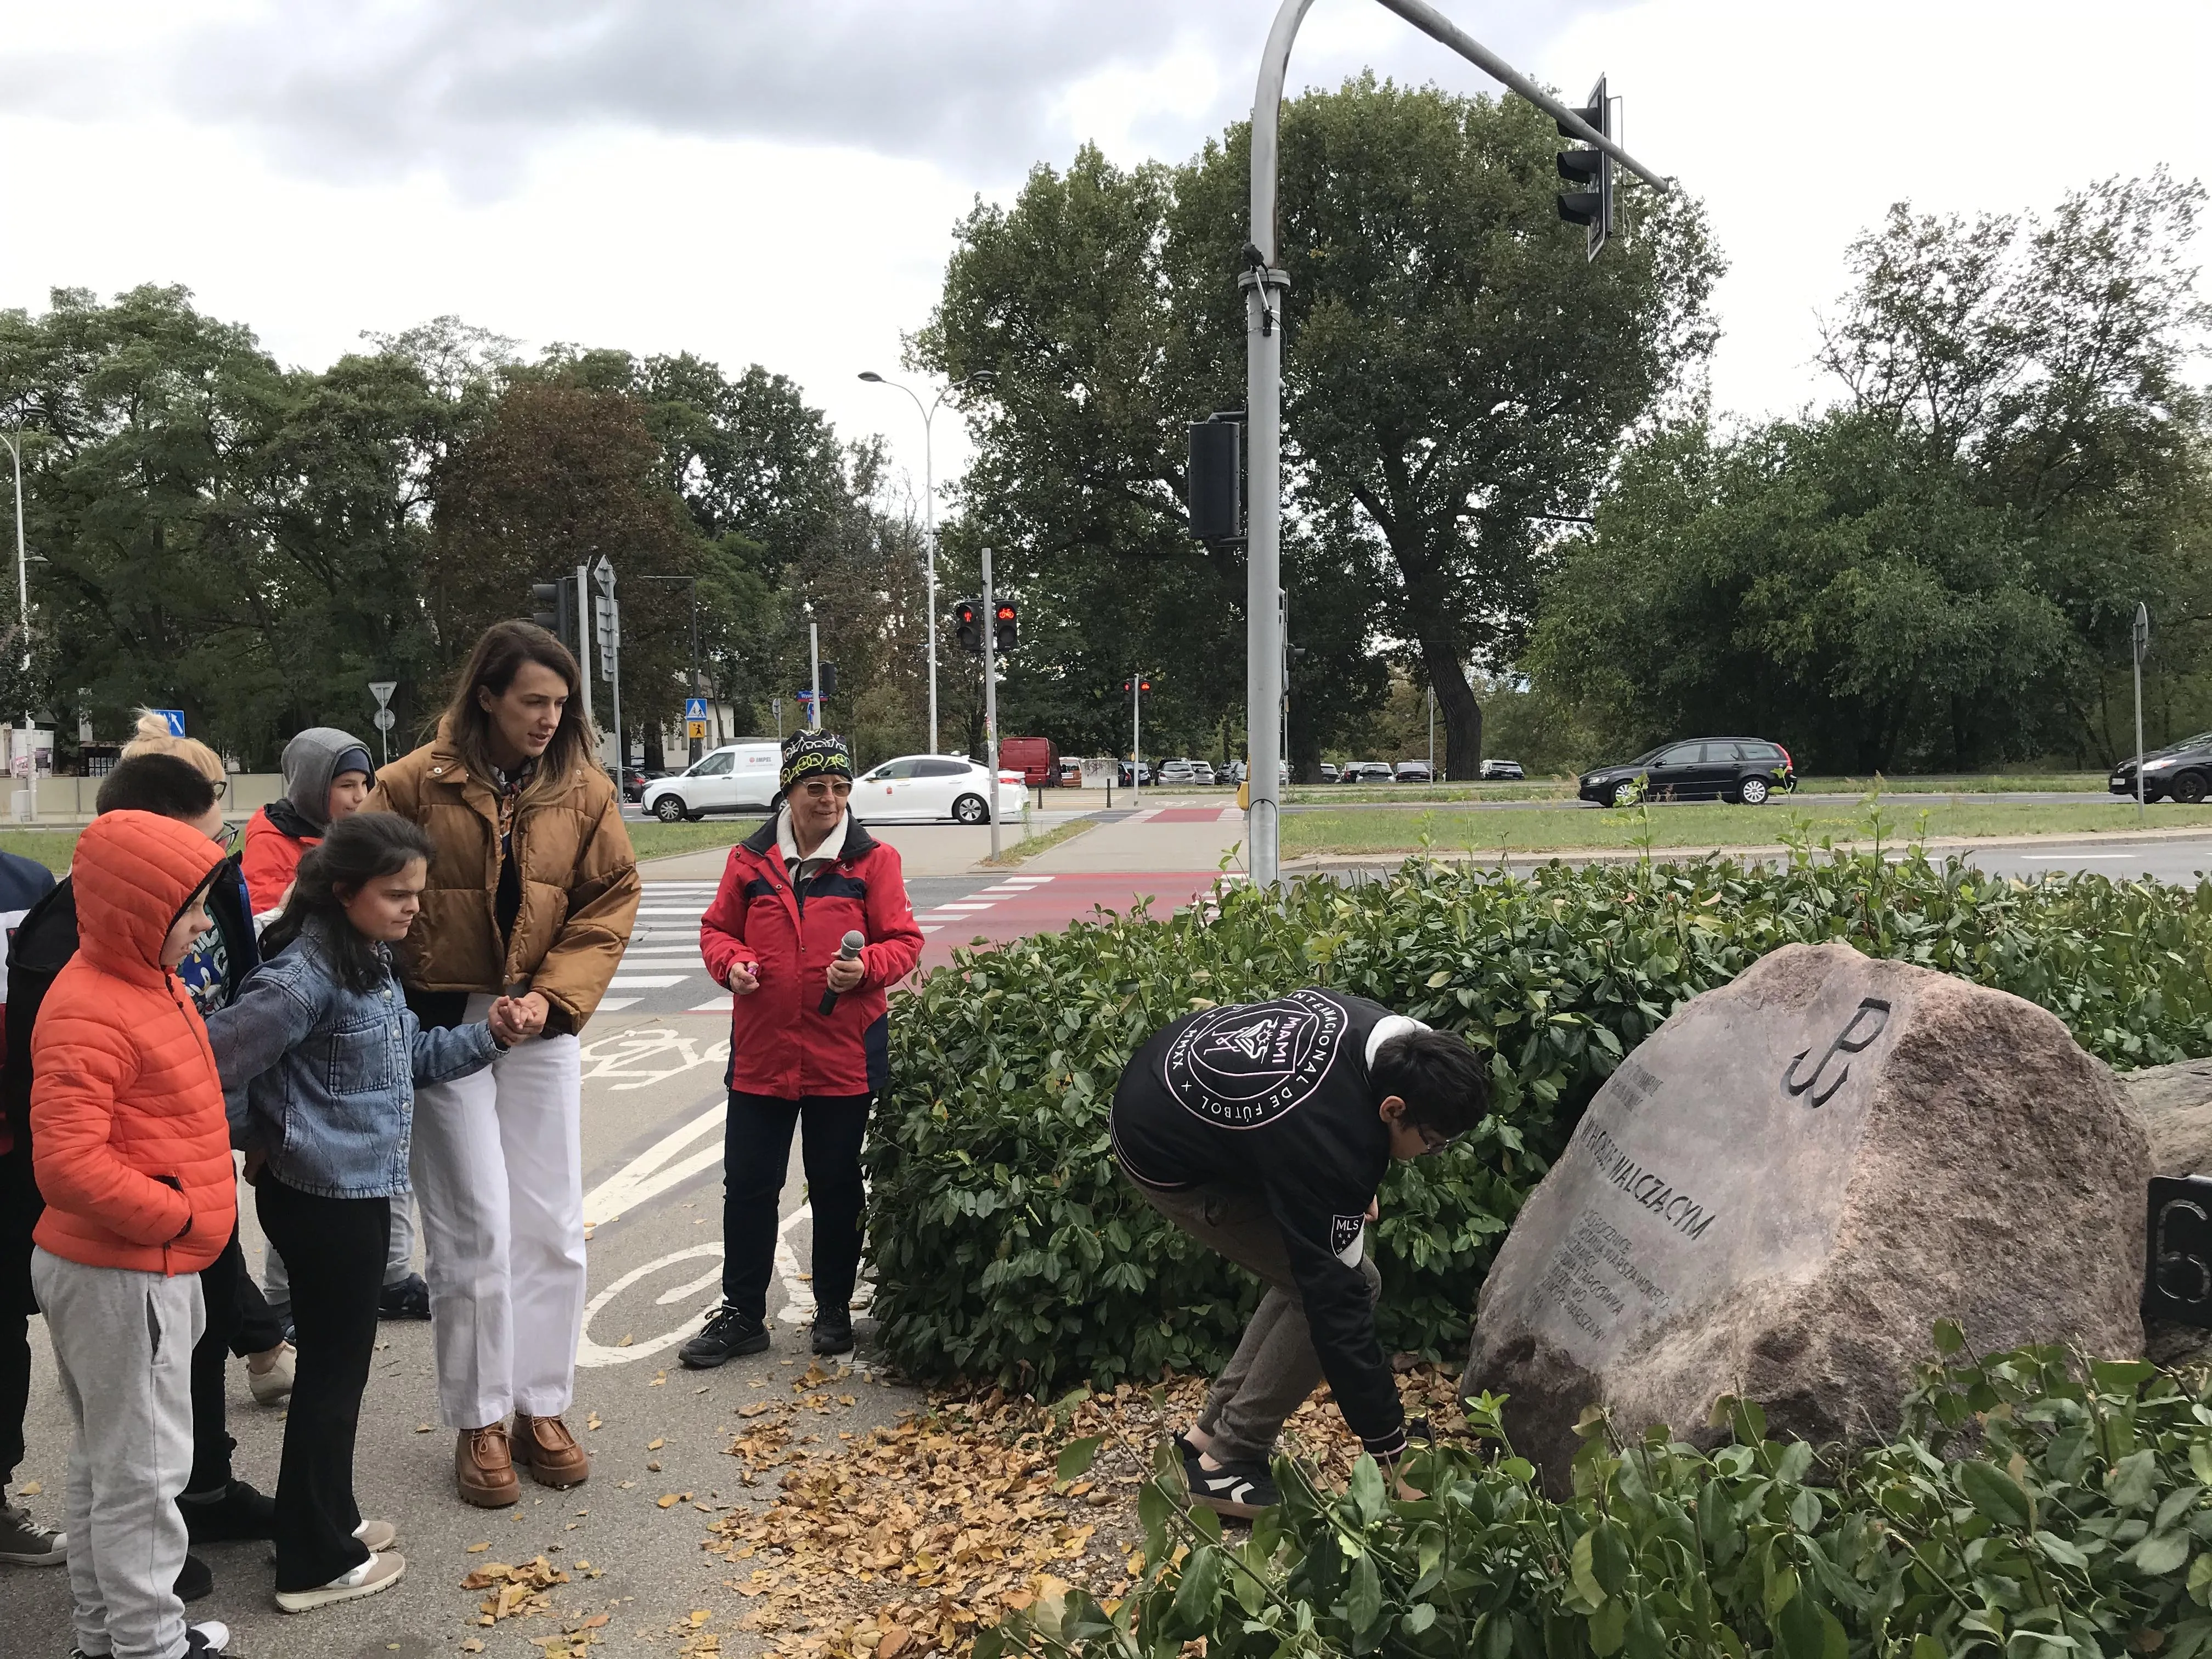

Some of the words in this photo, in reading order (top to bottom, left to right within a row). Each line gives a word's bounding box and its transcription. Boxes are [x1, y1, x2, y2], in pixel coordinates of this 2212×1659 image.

[1172, 1028, 1197, 1070] MMXX
[1272, 1016, 1302, 1063] MIAMI
[1201, 1095, 1262, 1122] FÚTBOL
[1269, 1086, 1293, 1108] DE
[1607, 1152, 1716, 1241] WALCZĄCYM
[1336, 1219, 1359, 1231] MLS
